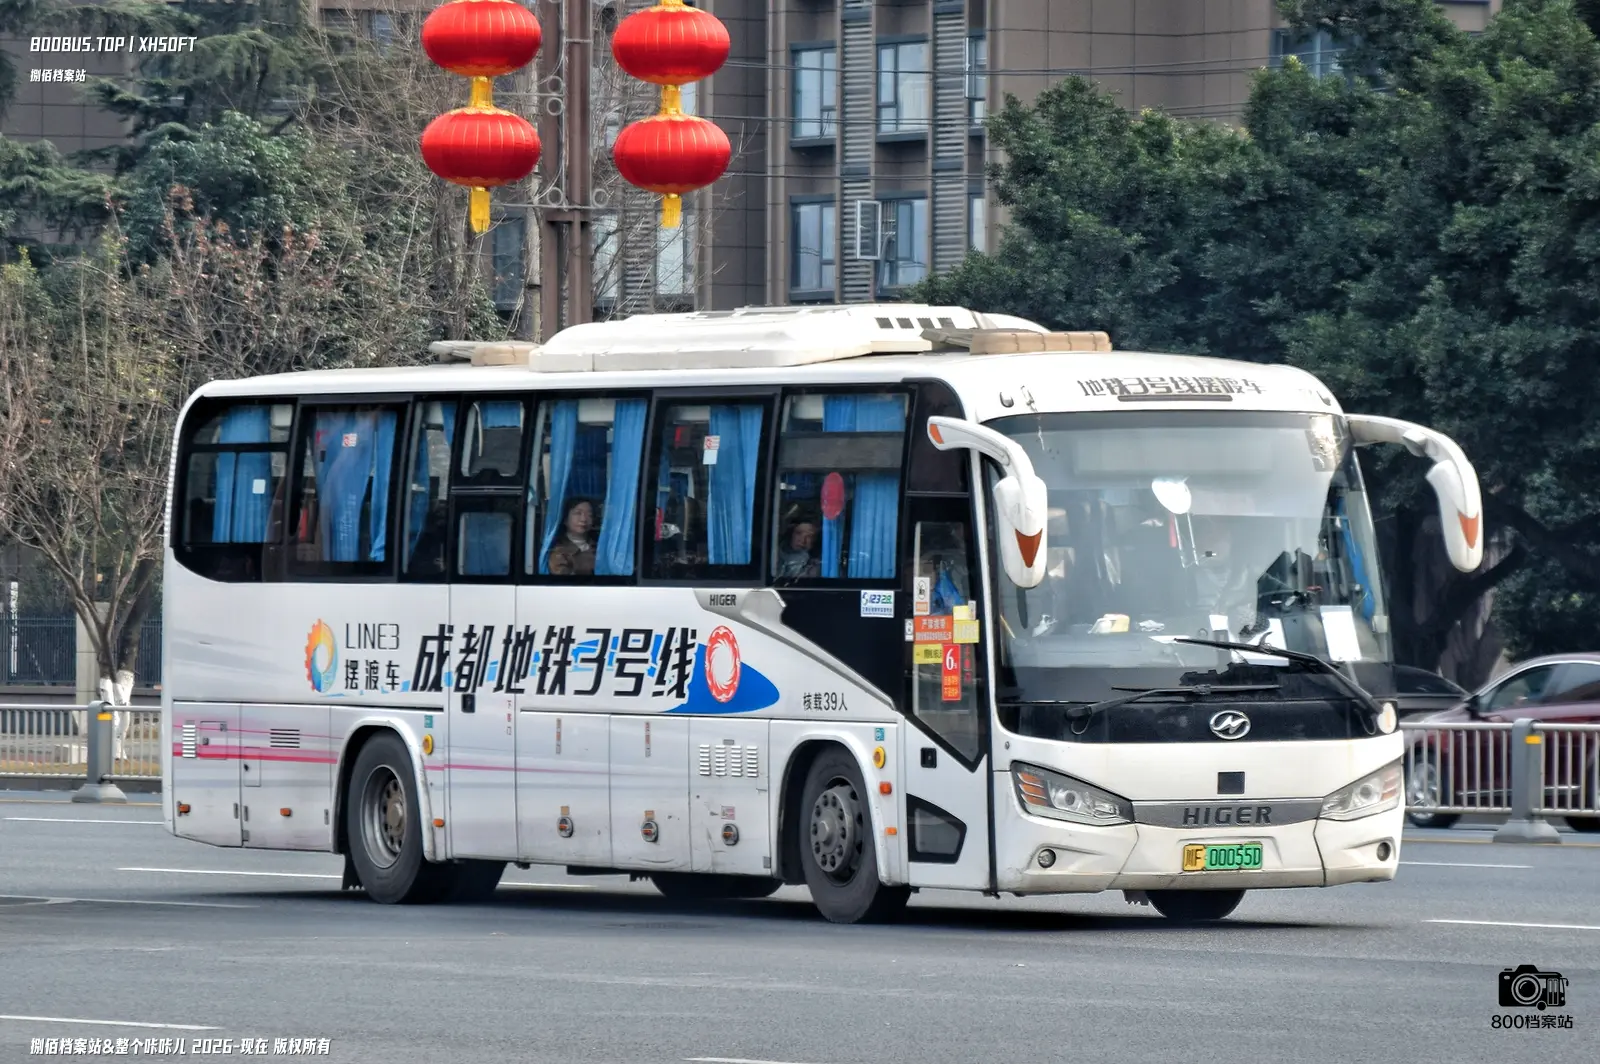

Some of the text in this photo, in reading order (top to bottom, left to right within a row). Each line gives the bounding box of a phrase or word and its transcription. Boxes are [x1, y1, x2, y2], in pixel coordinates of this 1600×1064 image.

[709, 593, 737, 606] HIGER
[410, 624, 698, 699] 成都地铁3号线
[344, 658, 400, 692] 摆渡车
[803, 692, 848, 711] 核载39人
[1182, 806, 1272, 825] HIGER
